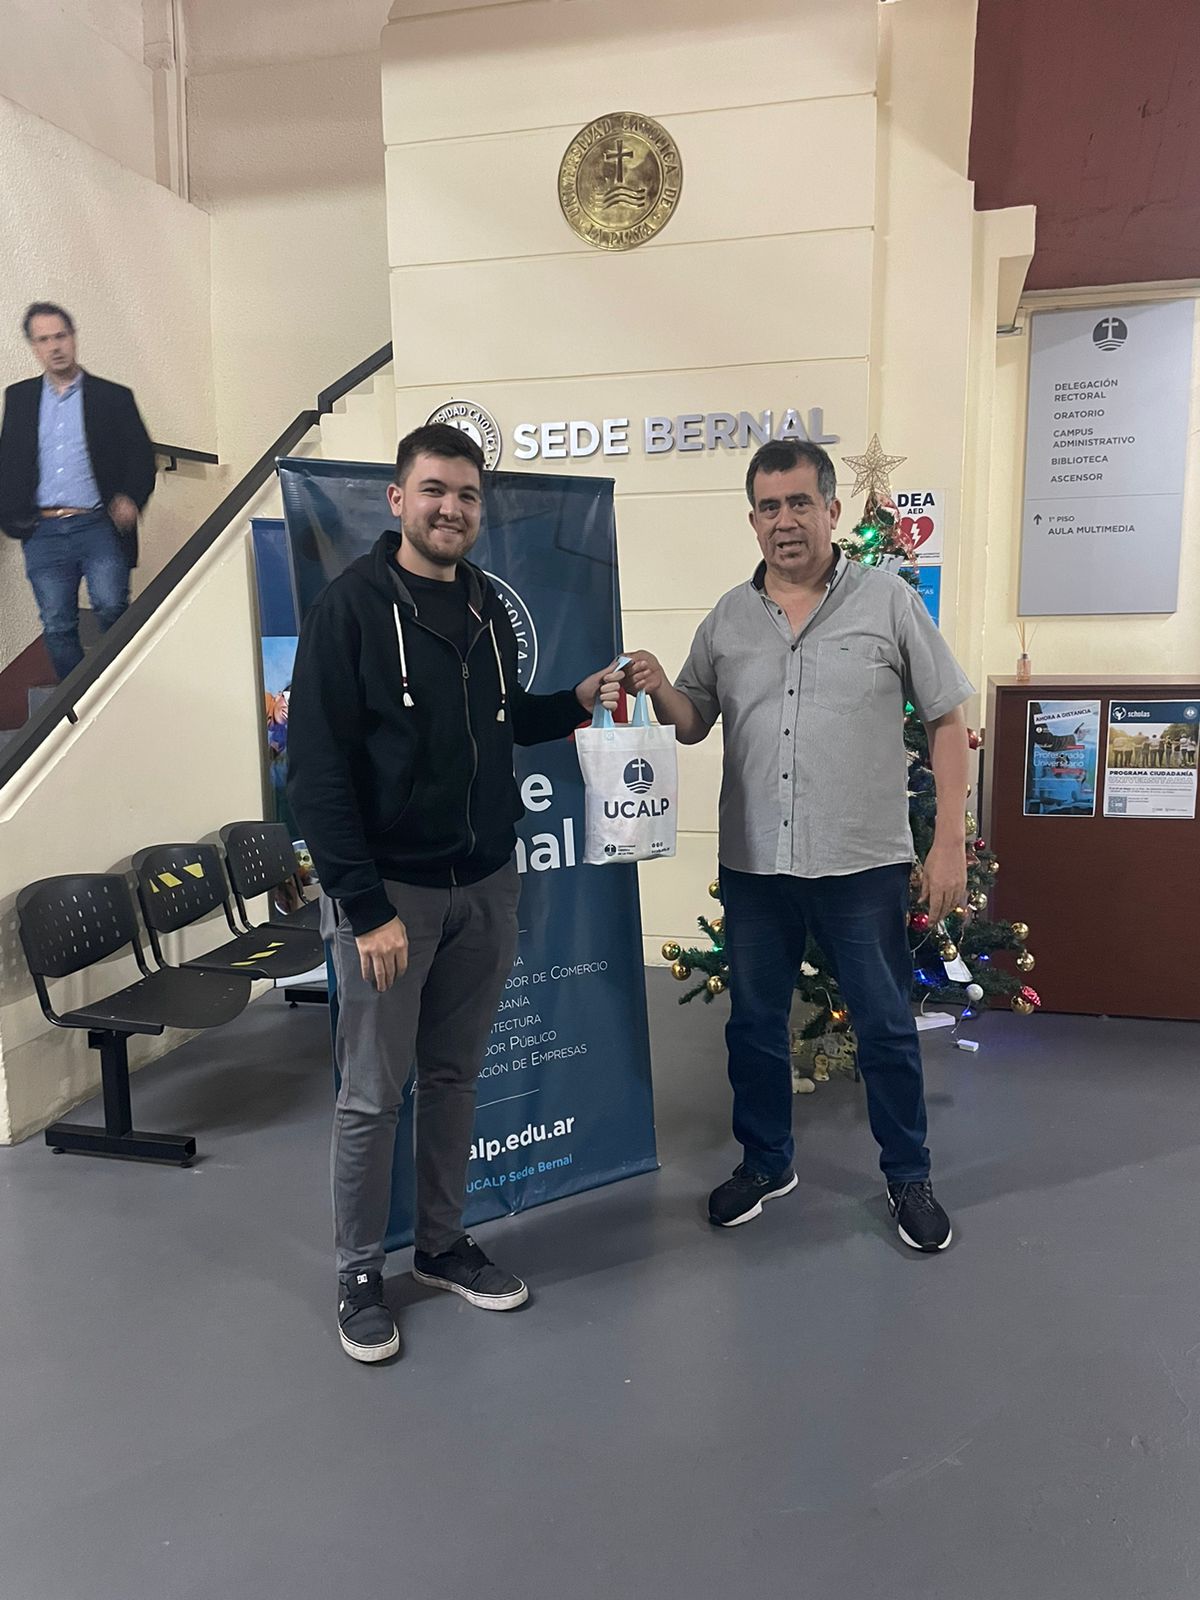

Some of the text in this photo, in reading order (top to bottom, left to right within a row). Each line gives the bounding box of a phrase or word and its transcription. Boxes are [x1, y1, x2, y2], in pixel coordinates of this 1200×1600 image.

[1054, 378, 1119, 392] DELEGACIÓN
[1054, 391, 1107, 402] RECTORAL
[1053, 409, 1105, 420] ORATORIO
[469, 408, 496, 453] CATOLICA
[513, 407, 841, 460] SEDE BERNAL
[1053, 428, 1094, 438] CAMPUS
[1052, 436, 1136, 449] ADMINISTRATIVO
[1051, 455, 1109, 466] BIBLIOTECA
[1050, 473, 1103, 483] ASCENSOR
[897, 492, 936, 508] DEA
[1048, 525, 1136, 536] AULA MULTIMEDIA
[1036, 713, 1055, 722] AHORA
[1062, 708, 1092, 718] DISTANCIA
[1128, 710, 1151, 718] scholas
[603, 797, 670, 819] UCALP
[509, 1165, 535, 1182] Sede
[538, 1153, 573, 1173] Bernal
